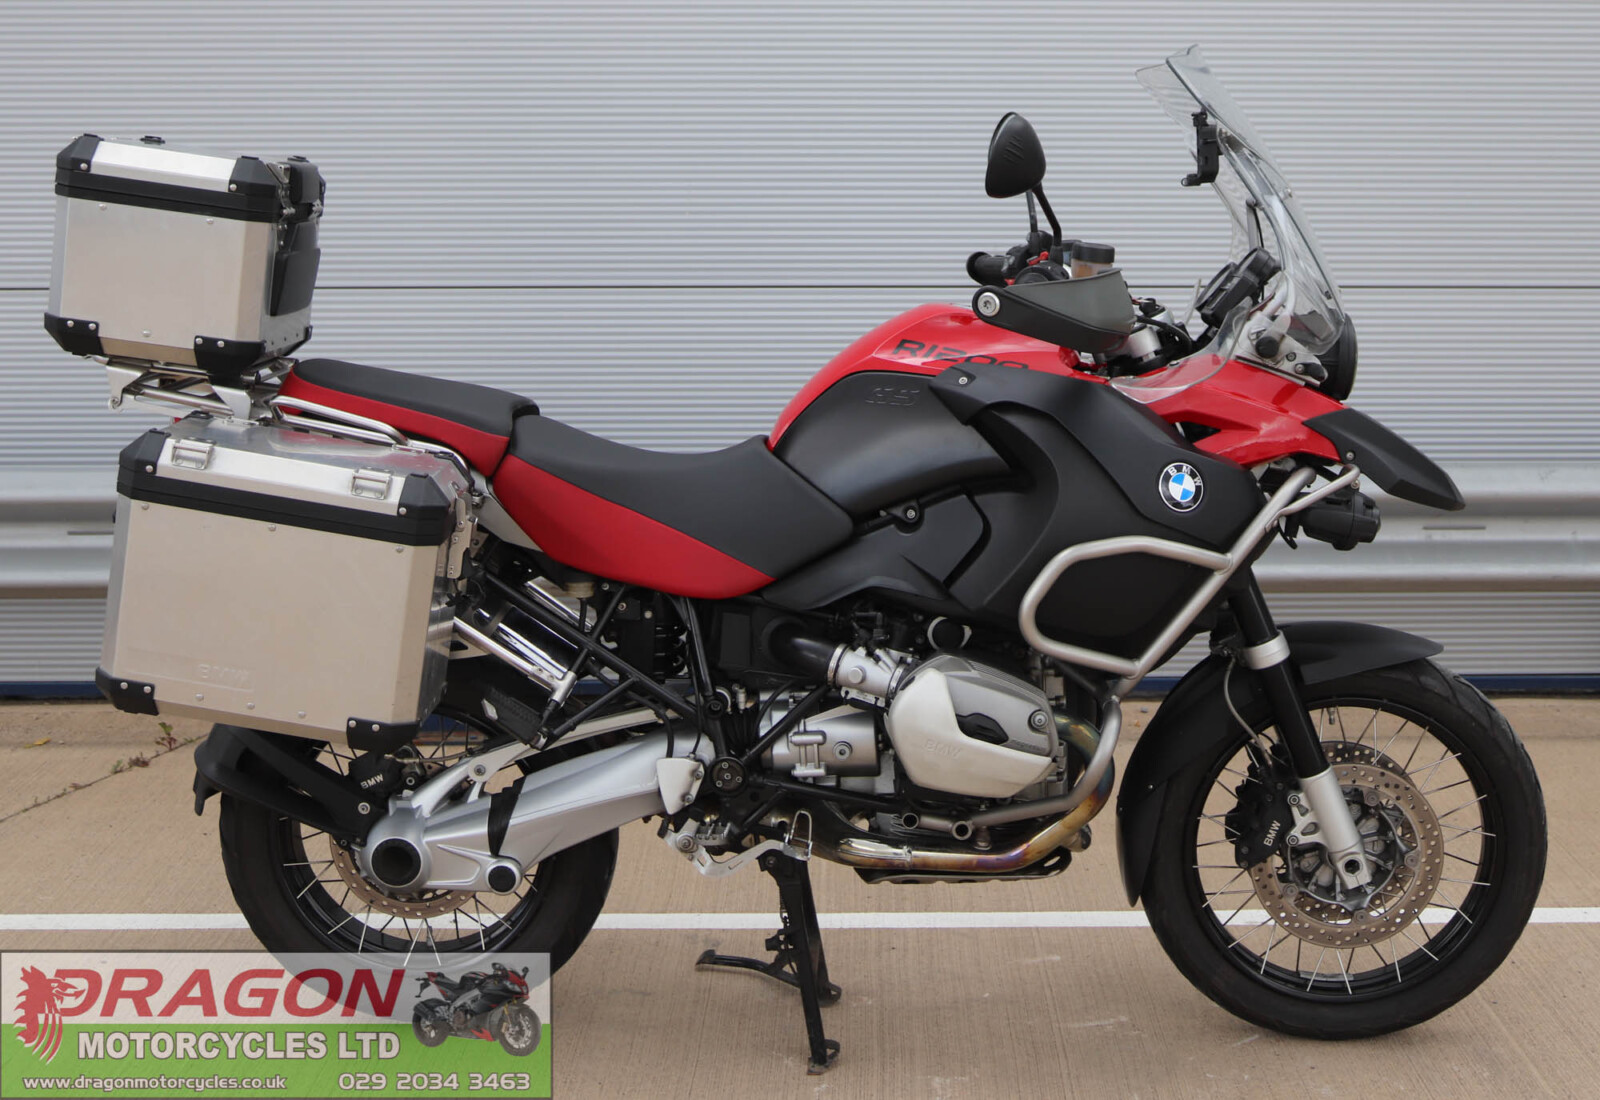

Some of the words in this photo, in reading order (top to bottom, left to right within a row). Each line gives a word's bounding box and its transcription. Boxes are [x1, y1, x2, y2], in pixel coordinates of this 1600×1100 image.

[1168, 464, 1202, 486] BMW
[923, 738, 963, 758] BMW
[360, 773, 384, 789] BMW
[1263, 820, 1281, 847] BMW
